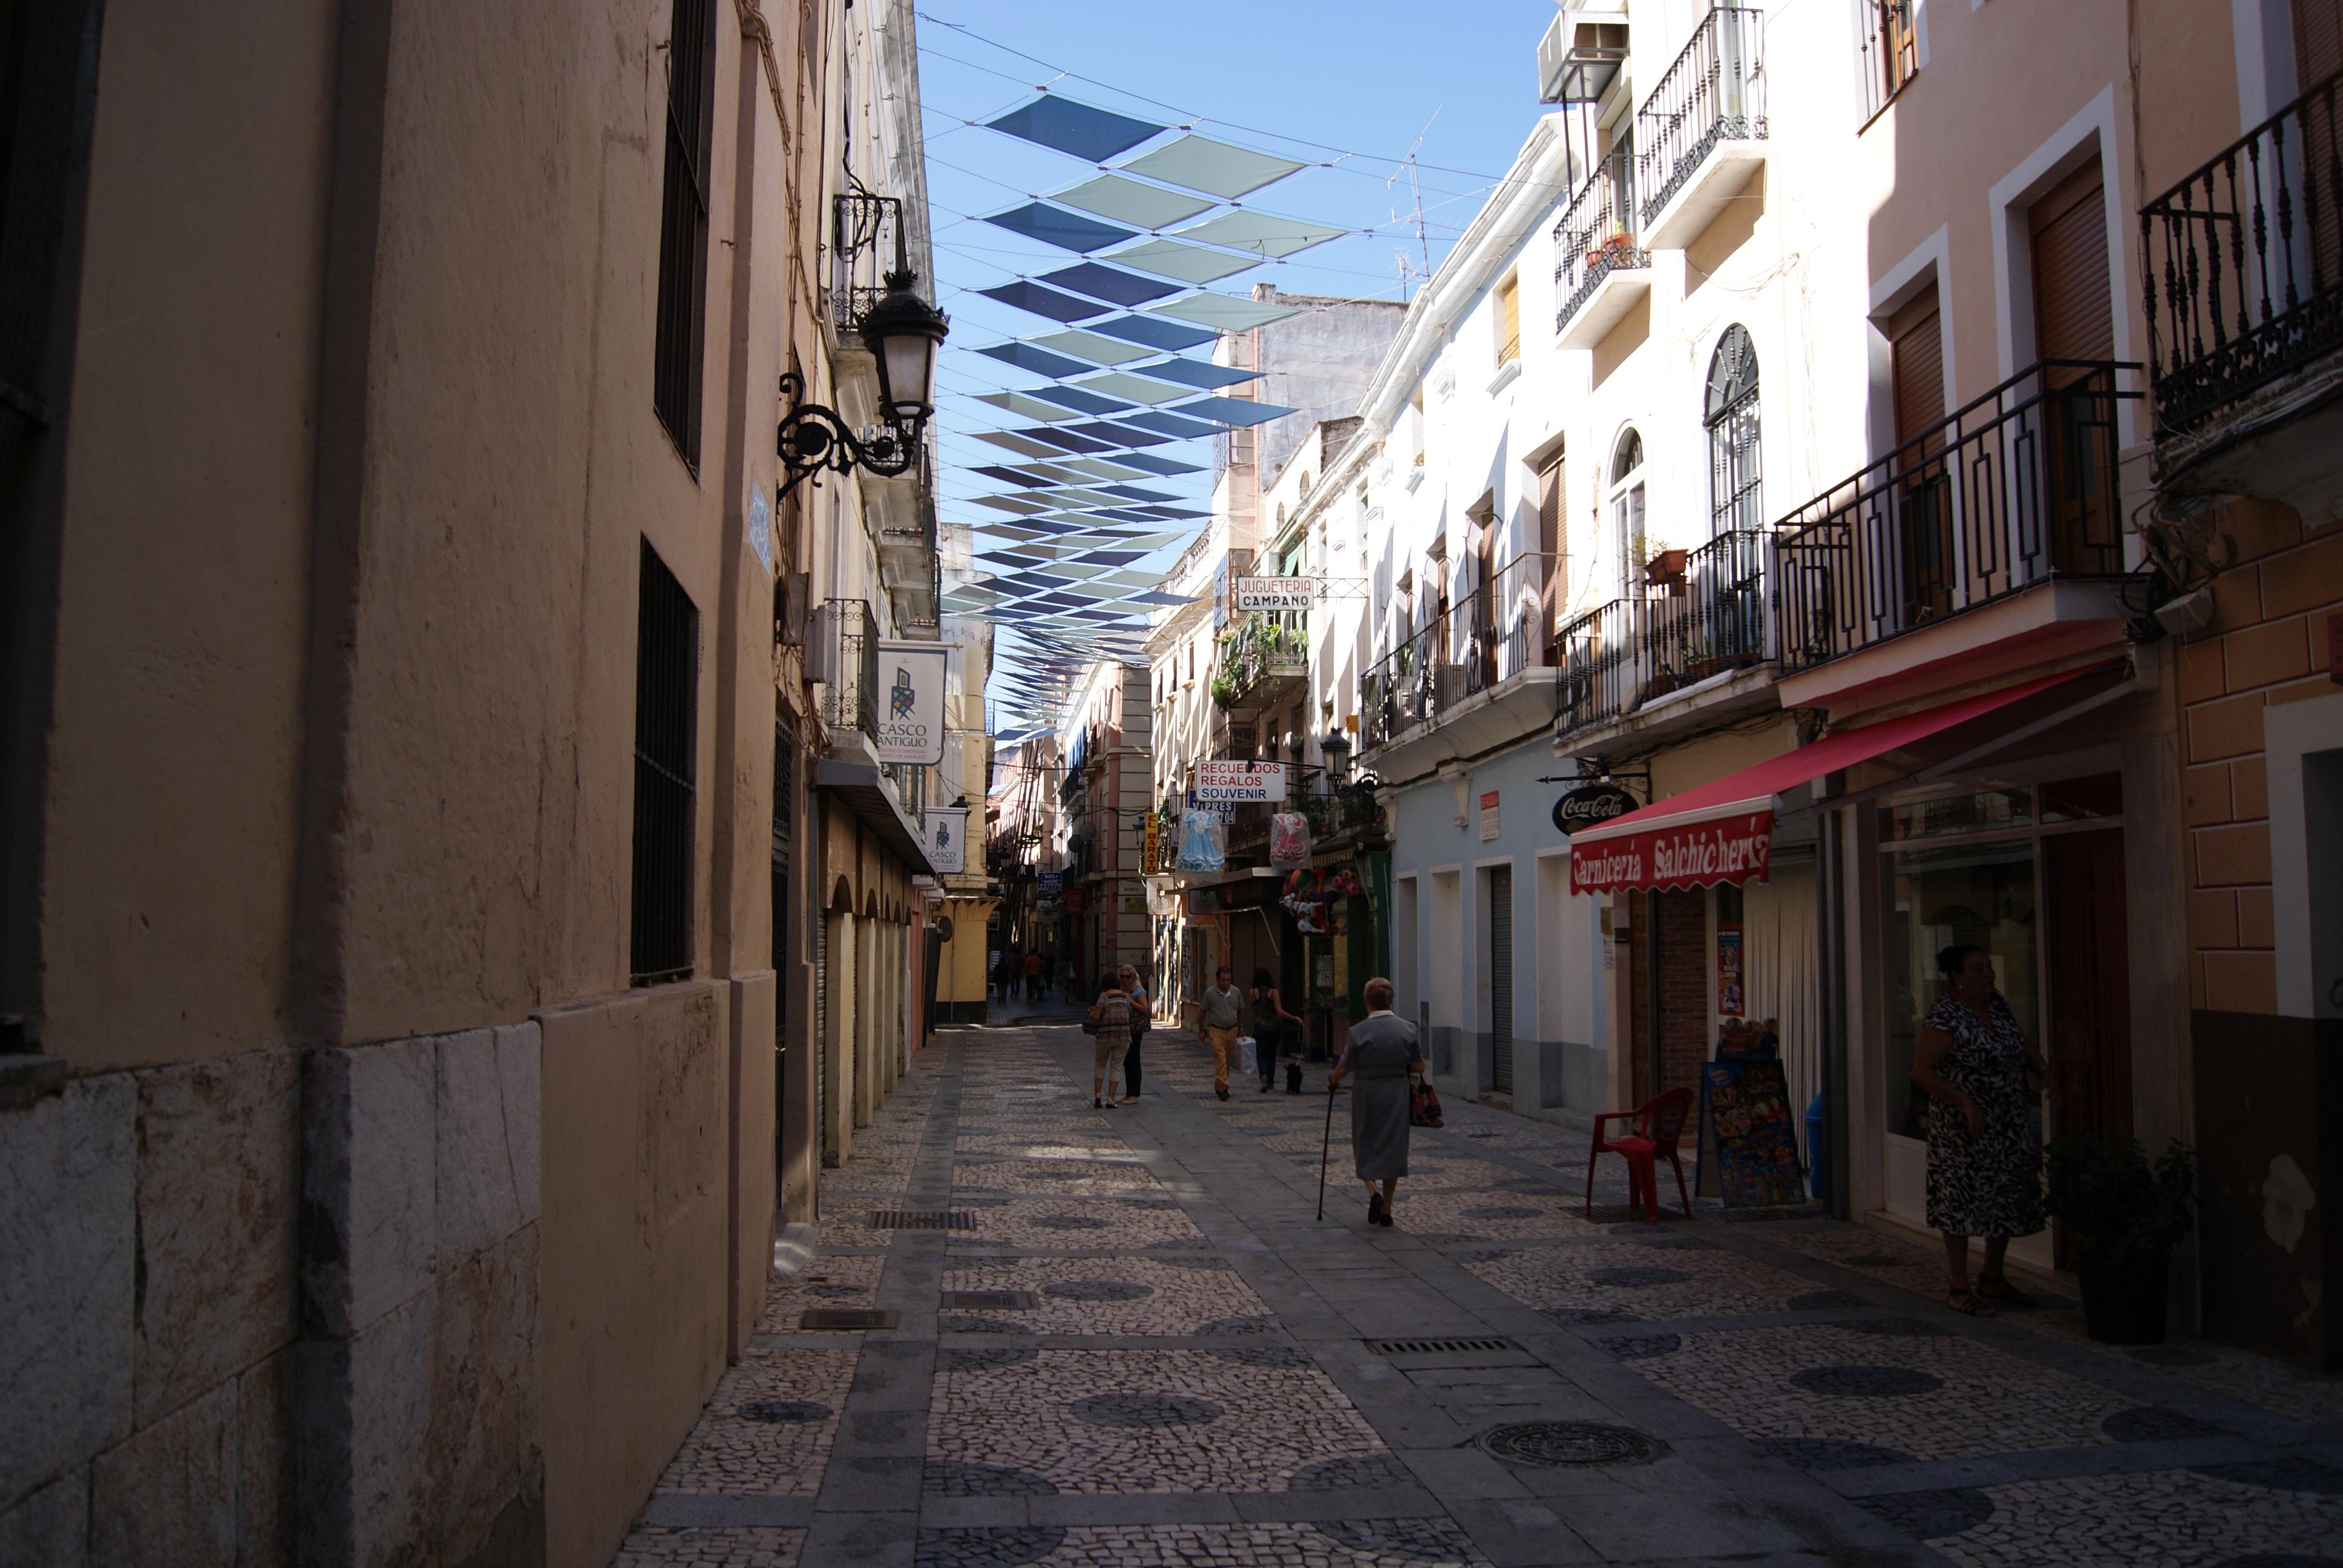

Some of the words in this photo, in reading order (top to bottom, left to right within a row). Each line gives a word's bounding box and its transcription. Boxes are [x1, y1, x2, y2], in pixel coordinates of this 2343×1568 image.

[1240, 580, 1311, 593] JUGUETERIA
[1244, 596, 1308, 606] CAMPANO
[877, 724, 926, 736] CASCO
[877, 736, 927, 747] ANTIGUO
[1201, 776, 1262, 786] REGALOS
[1202, 788, 1267, 799] SOUVENIR
[1561, 794, 1623, 820] Coca-Cola
[1147, 815, 1156, 828] EL
[1147, 833, 1156, 872] BARATO
[1573, 838, 1642, 886] Carnicería
